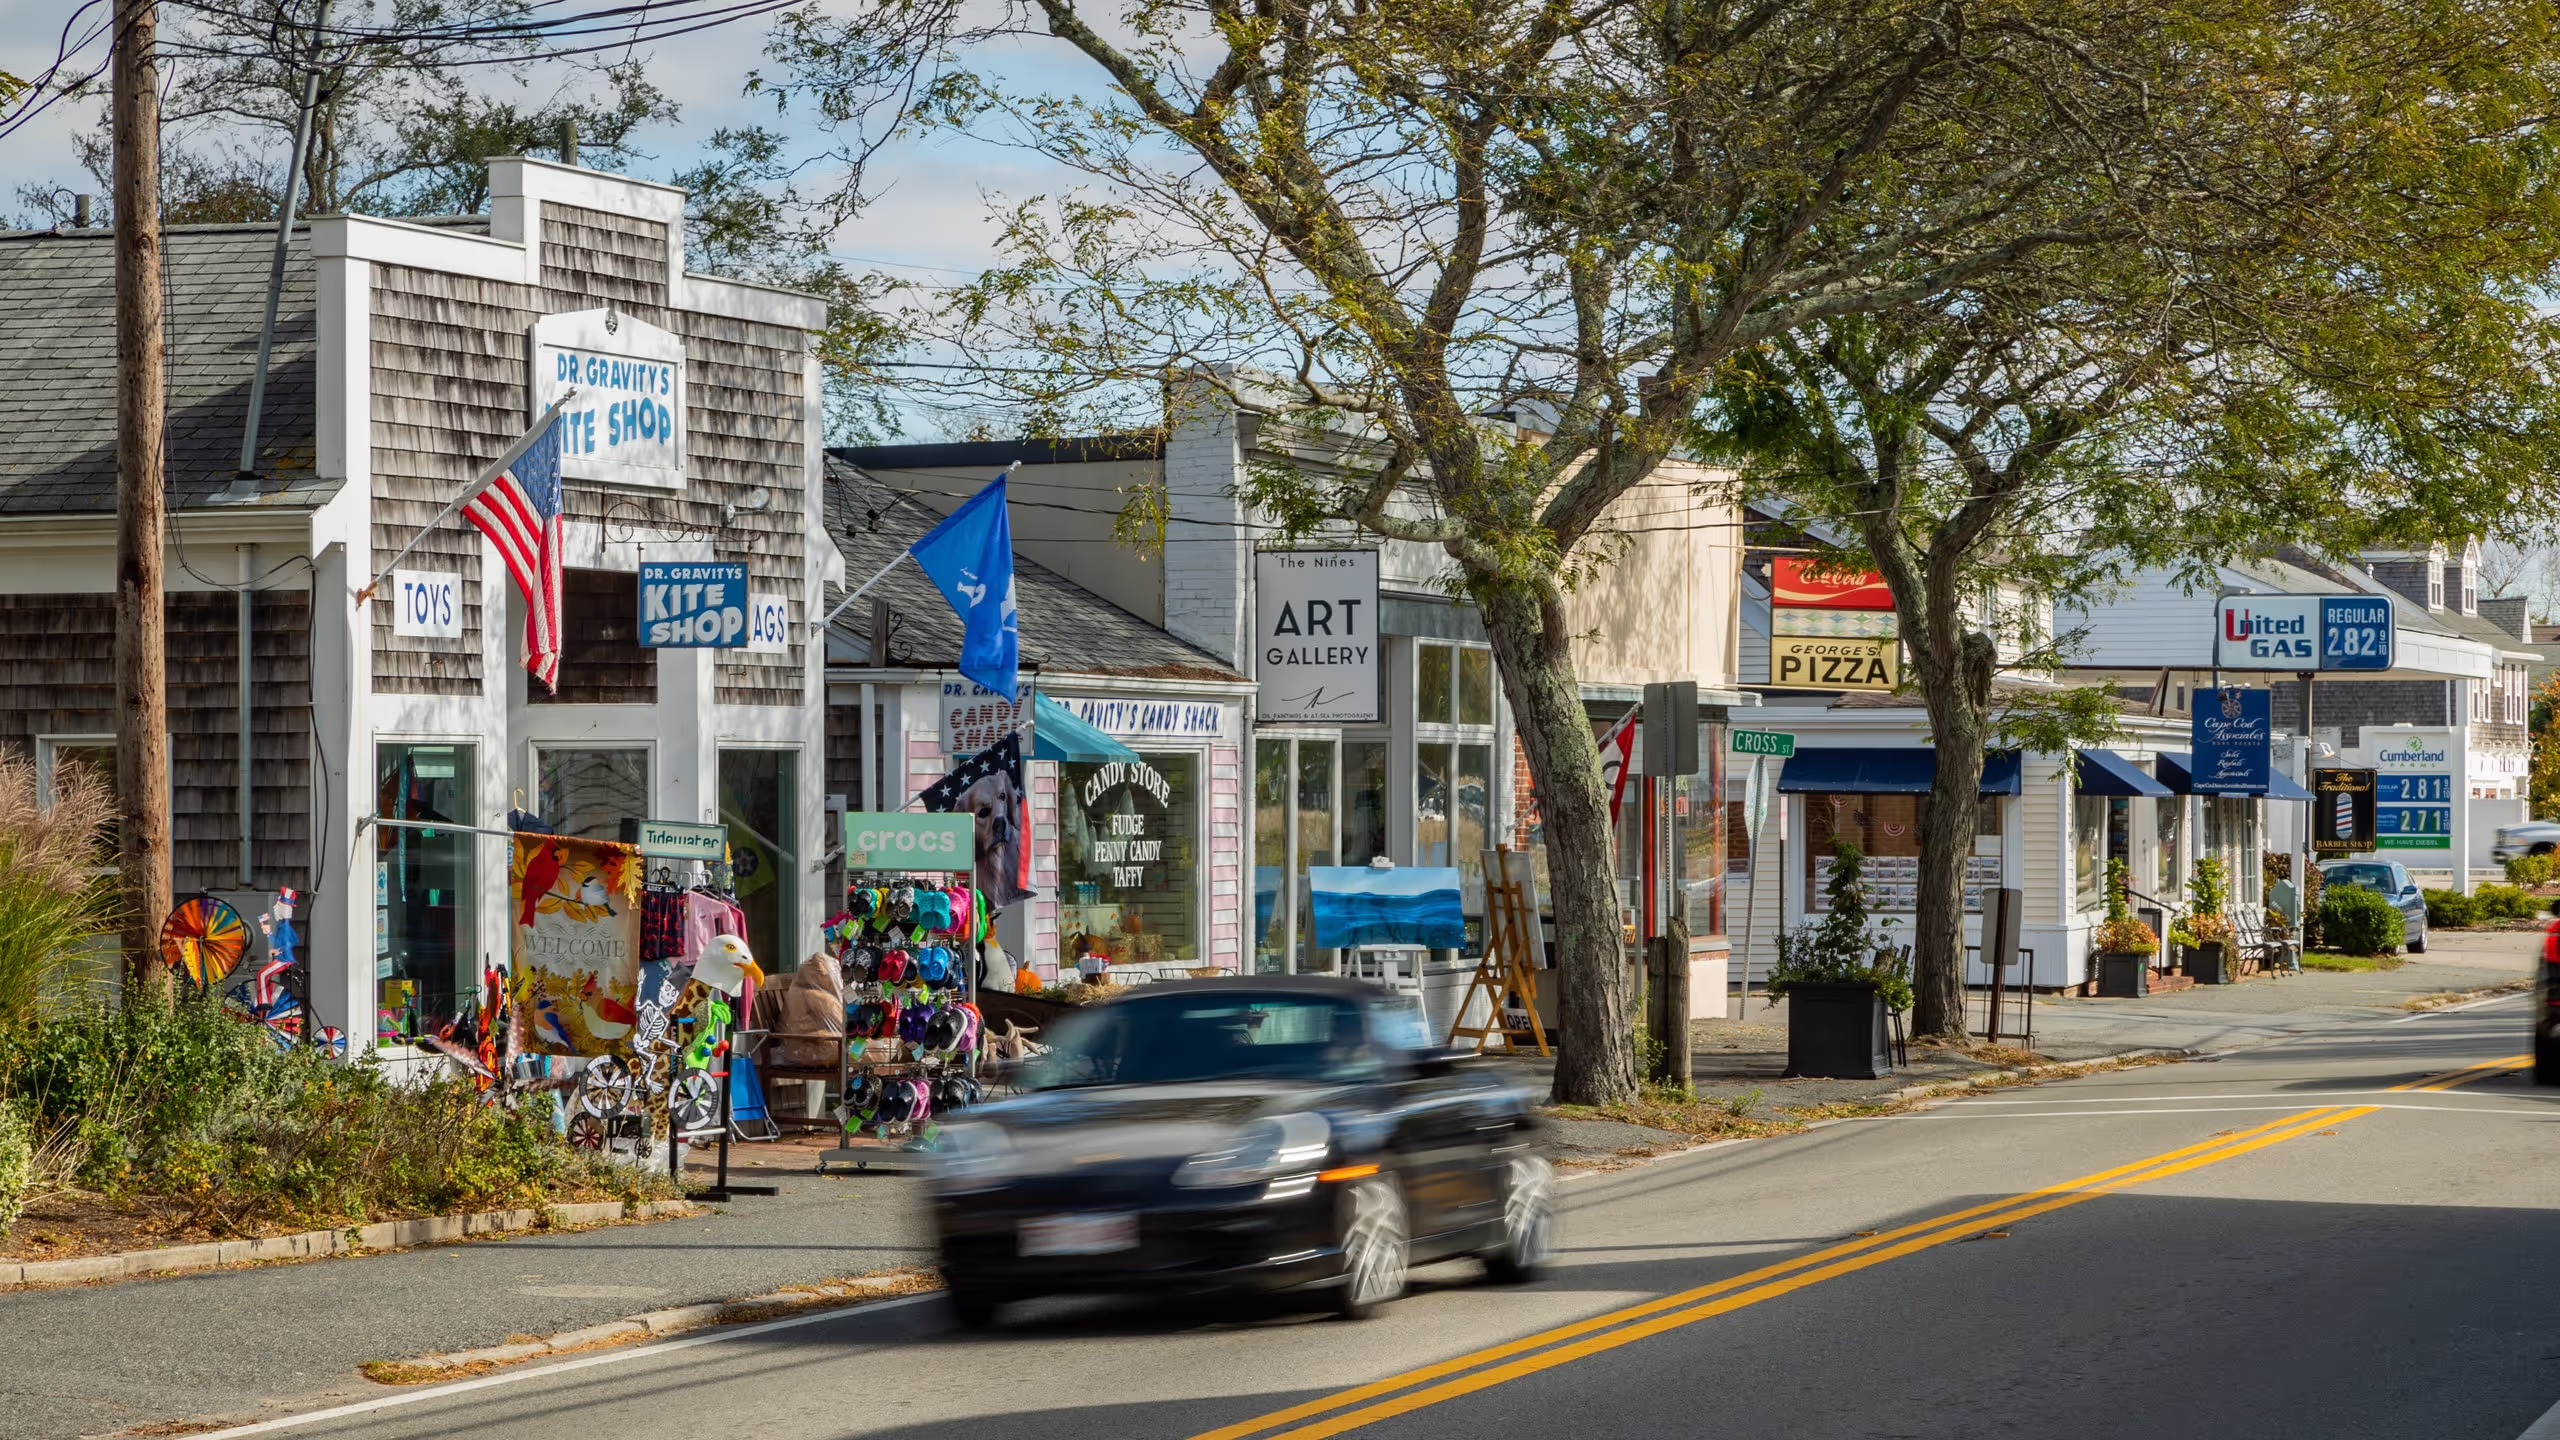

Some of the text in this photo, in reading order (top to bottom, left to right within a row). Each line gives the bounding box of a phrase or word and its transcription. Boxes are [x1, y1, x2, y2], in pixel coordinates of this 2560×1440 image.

[557, 352, 583, 384] DR.
[545, 397, 672, 454] ITE SHOP
[644, 566, 743, 580] DR. GRAVITY'S
[1279, 556, 1355, 569] The Nines
[404, 582, 451, 626] TOYS
[643, 583, 725, 623] KITE
[650, 606, 744, 645] SHOP
[753, 604, 785, 643] AGS
[1273, 599, 1362, 636] ART
[2225, 608, 2305, 642] United
[2327, 608, 2385, 624] REGULAR
[1266, 646, 1369, 666] GALLERY
[1790, 644, 1877, 656] GEORGE'S
[2250, 639, 2313, 658] GAS
[1780, 655, 1890, 684] PIZZA
[943, 683, 966, 696] DR.
[950, 698, 1024, 730] CANDY
[1141, 703, 1180, 731] CANDY
[1183, 705, 1220, 733] SHACK
[2204, 717, 2264, 733] Cape Cod
[1736, 732, 1790, 754] CROSS ST
[2198, 728, 2266, 743] Associates
[2379, 749, 2444, 762] Cumberland
[1084, 761, 1171, 809] CANDY STORE
[2318, 781, 2371, 792] Traditional
[2335, 772, 2353, 782] The
[2400, 778, 2441, 800] 2.81
[1111, 814, 1145, 836] FUDGE
[2400, 809, 2441, 832] 2.71
[857, 829, 957, 853] crocs
[1094, 840, 1162, 863] PENNY CANDY
[2316, 840, 2348, 849] BARBER
[1112, 866, 1144, 888] TAFFY
[523, 934, 626, 958] WELCOME
